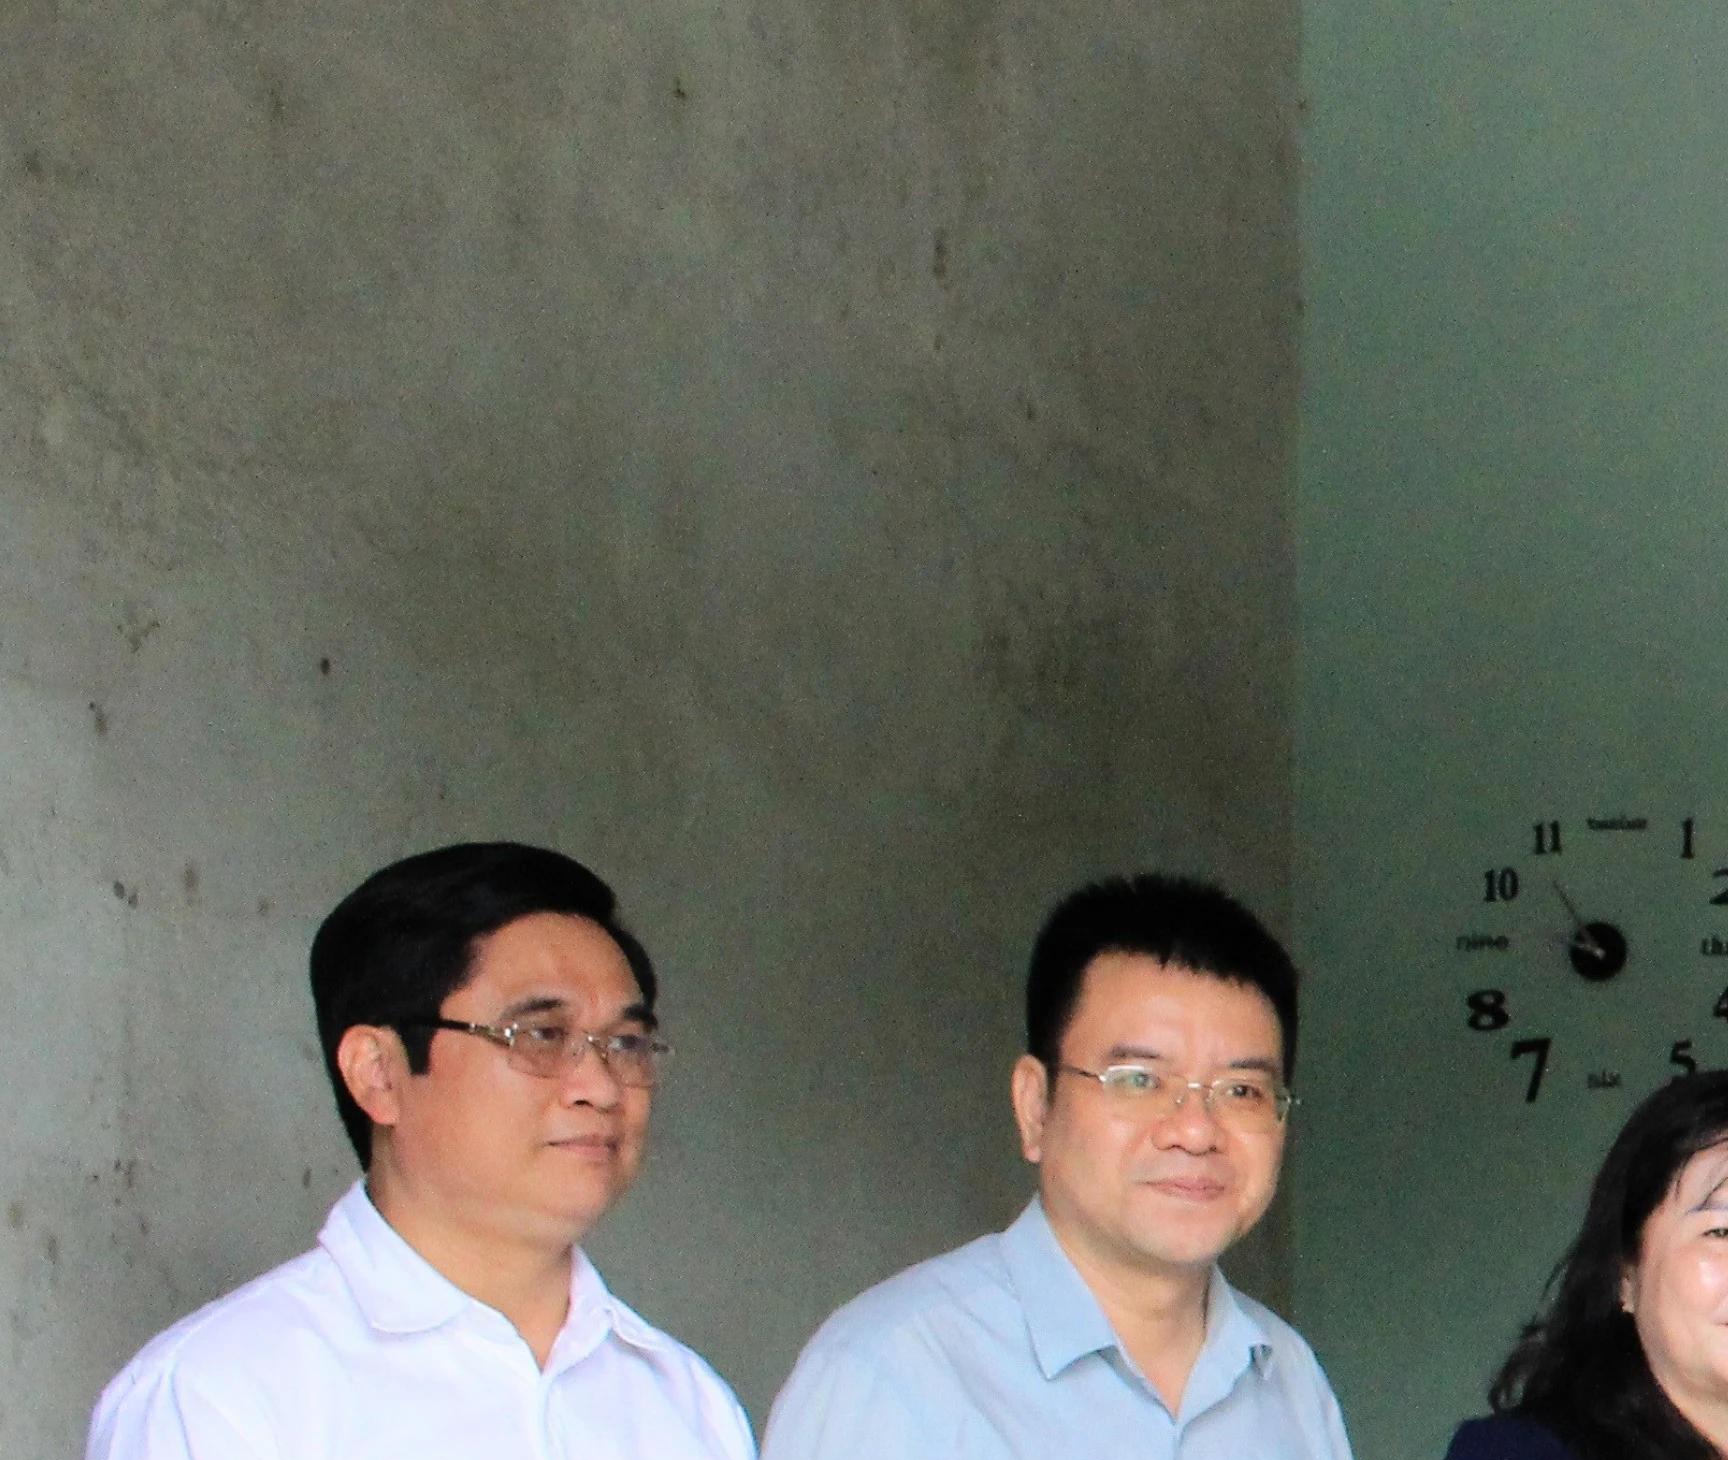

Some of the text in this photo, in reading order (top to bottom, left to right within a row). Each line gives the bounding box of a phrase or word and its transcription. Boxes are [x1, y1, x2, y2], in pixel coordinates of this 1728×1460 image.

[1533, 819, 1562, 855] 11
[1681, 817, 1695, 859] 1
[1483, 867, 1519, 902] 10
[1467, 989, 1511, 1031] 8
[1510, 1037, 1552, 1103] 7
[1669, 1038, 1697, 1076] 5
